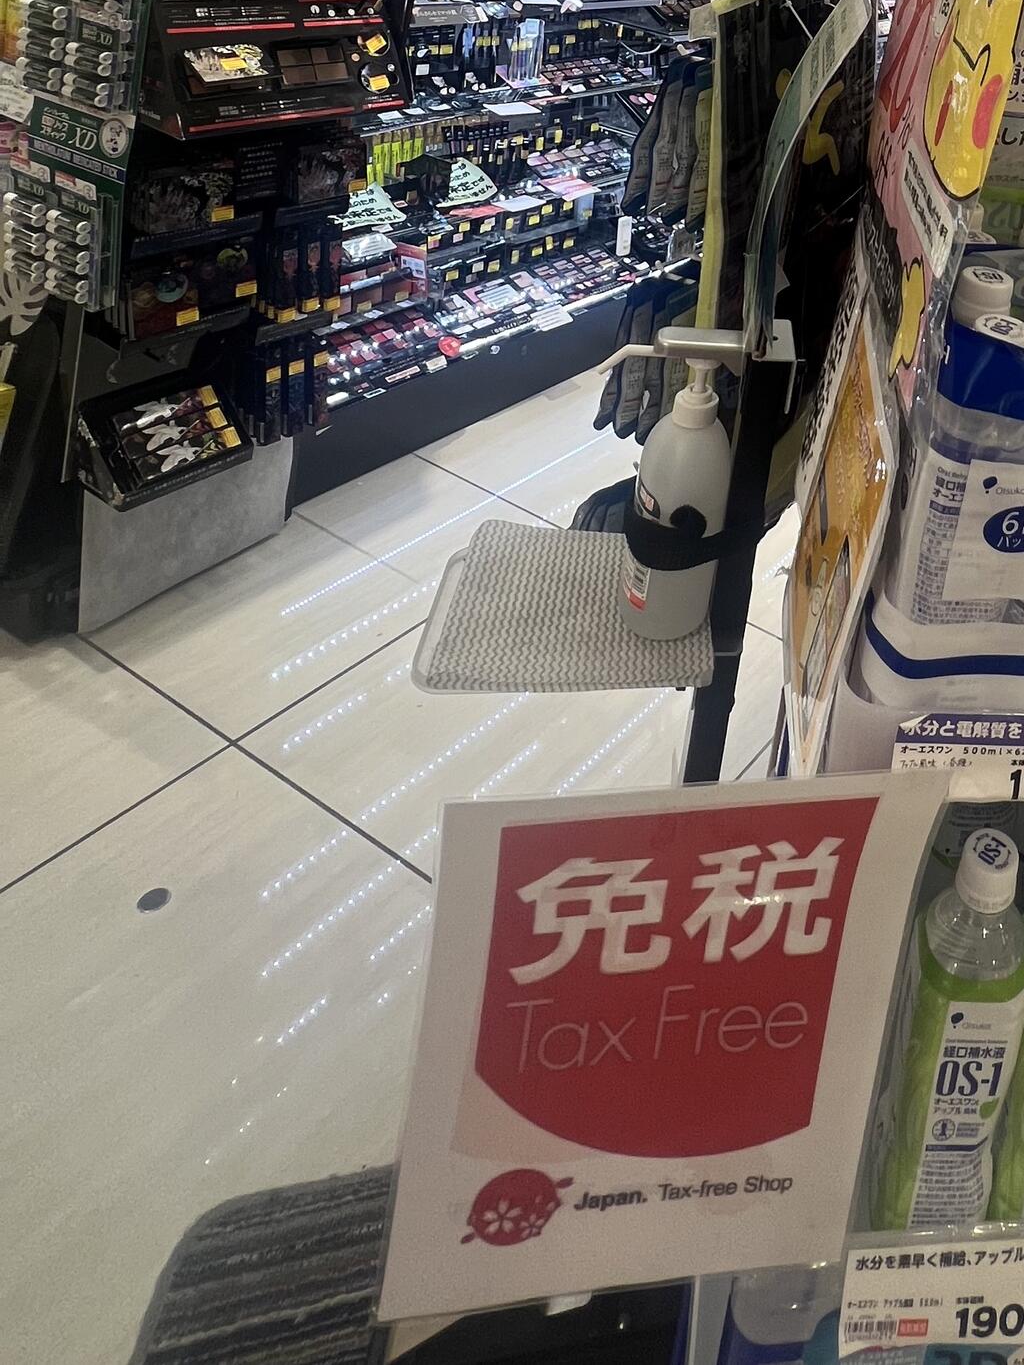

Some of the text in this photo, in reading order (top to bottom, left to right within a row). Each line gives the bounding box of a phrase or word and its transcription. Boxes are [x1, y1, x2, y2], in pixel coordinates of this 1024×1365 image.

[68, 126, 98, 152] XD
[900, 745, 953, 754] オーエスワン
[508, 836, 846, 986] 免税
[506, 983, 810, 1075] Tax Free
[943, 1045, 1007, 1059] 経口補水液
[935, 1060, 1003, 1097] OS-1
[573, 1174, 794, 1212] Japan. Tax-free Shop
